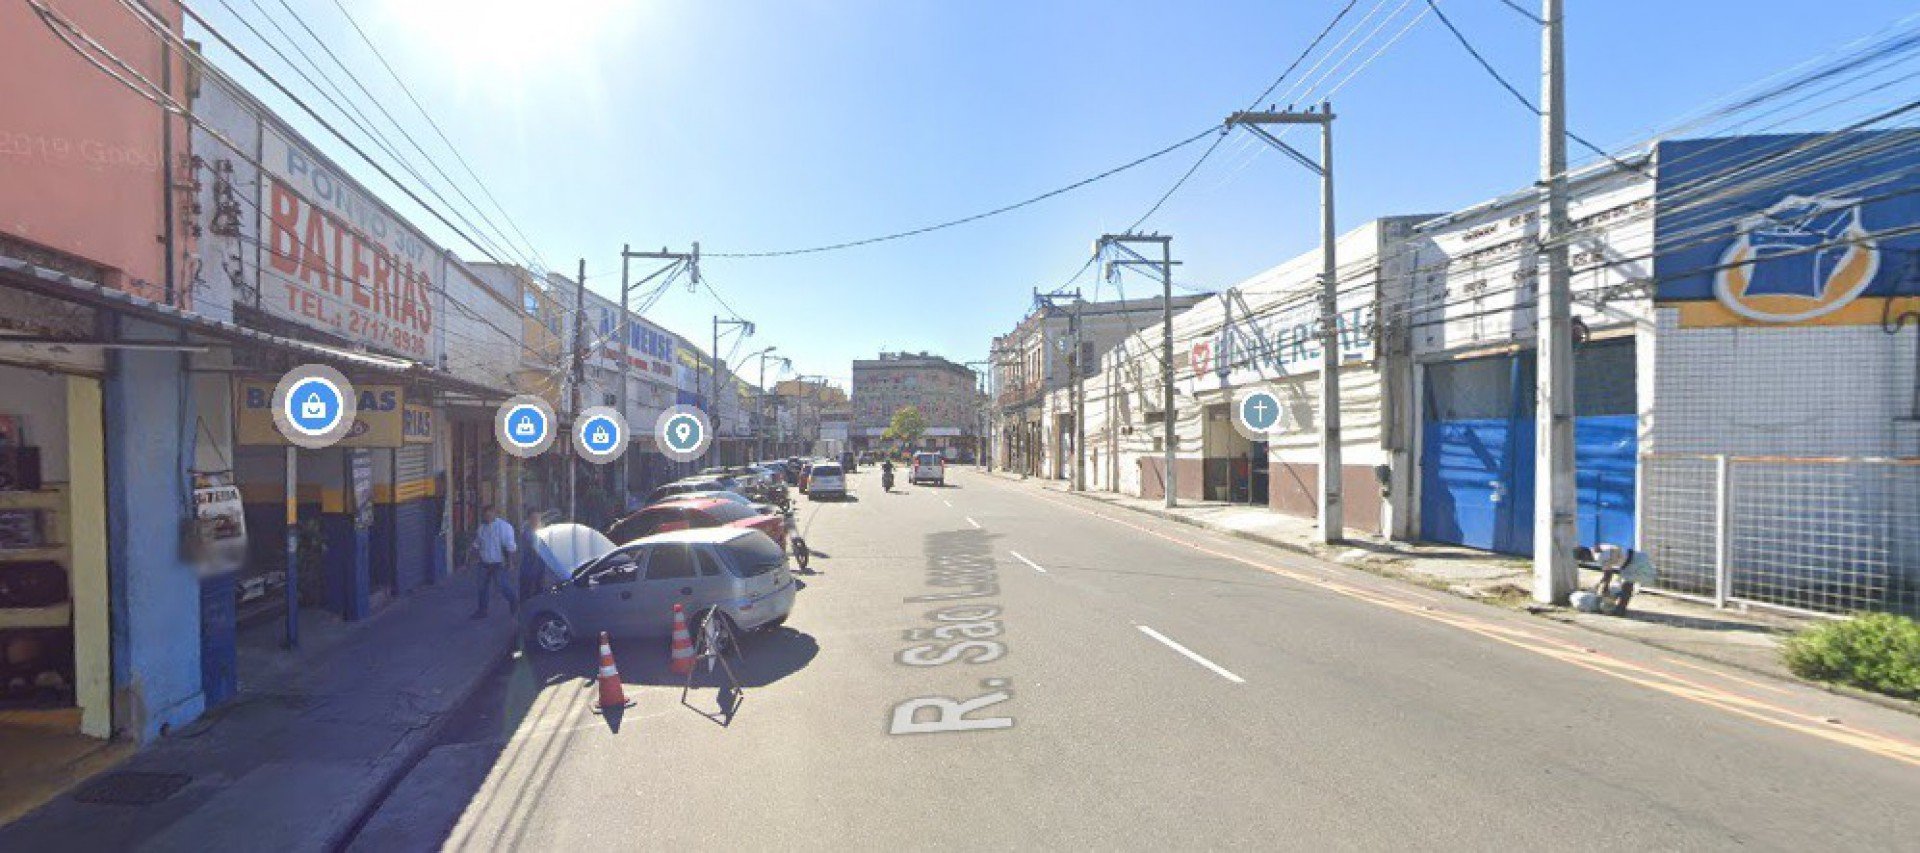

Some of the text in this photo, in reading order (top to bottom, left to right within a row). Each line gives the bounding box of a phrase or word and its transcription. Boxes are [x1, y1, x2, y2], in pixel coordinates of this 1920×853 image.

[270, 181, 433, 335] BATERIAS
[286, 146, 425, 263] PONTO 307
